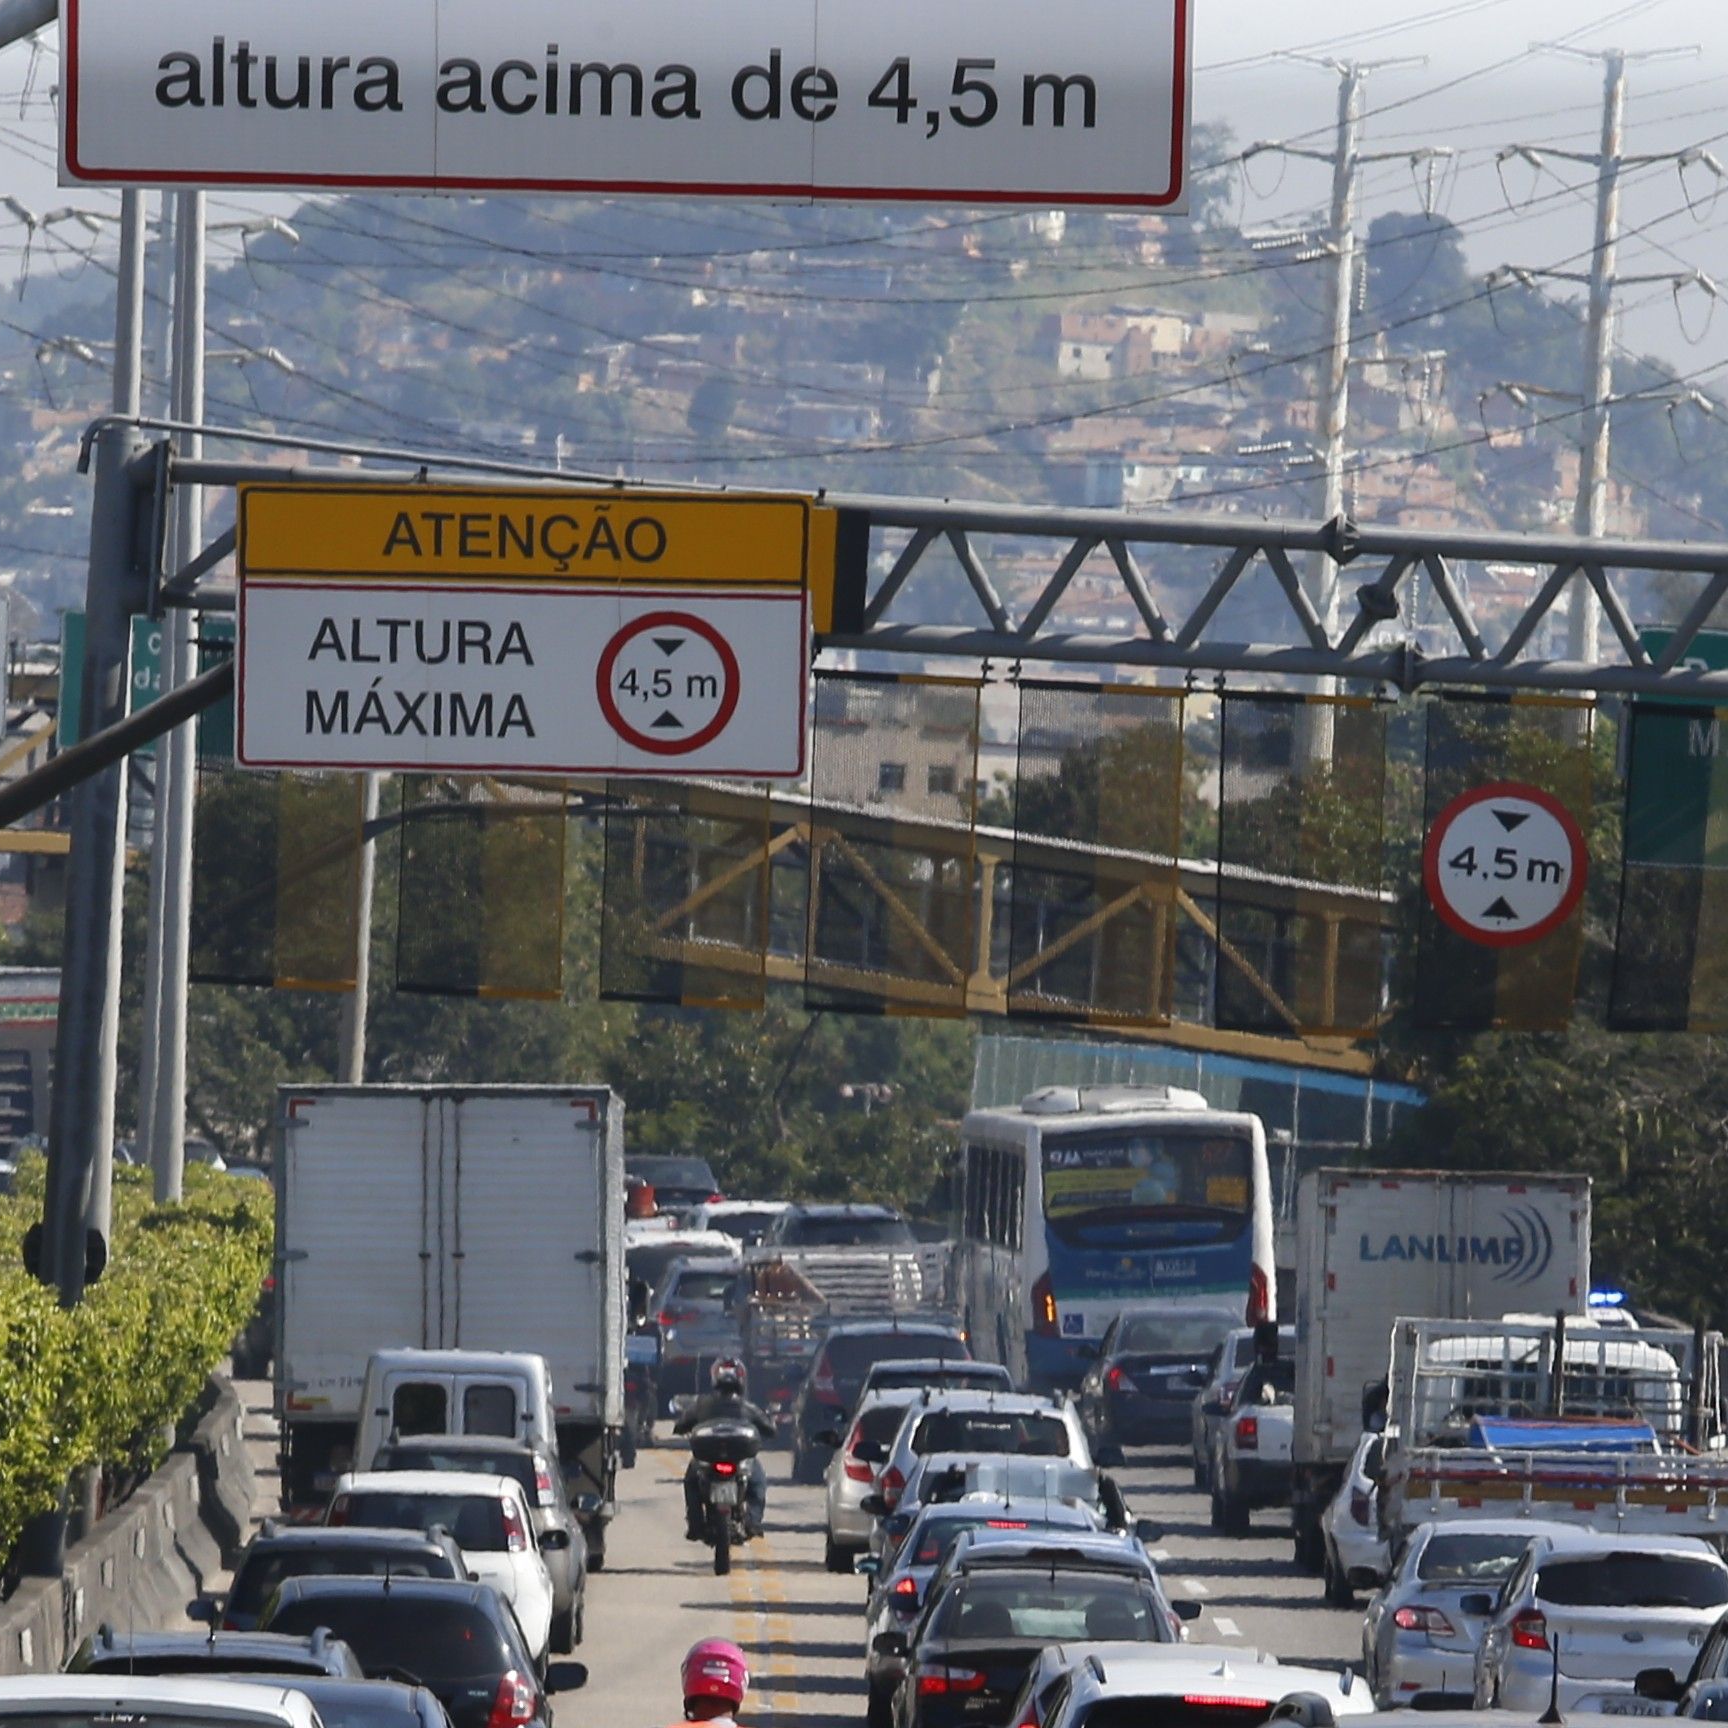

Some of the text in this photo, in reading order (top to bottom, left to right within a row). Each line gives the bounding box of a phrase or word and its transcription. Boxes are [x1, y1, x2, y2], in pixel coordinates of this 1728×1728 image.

[155, 34, 1097, 139] altura acima de 4,5 m
[382, 504, 668, 571] ATENÇÃO
[308, 618, 535, 666] ALTURA
[304, 677, 537, 738] MÁXIMA
[618, 667, 719, 703] 4,5 m
[1526, 858, 1562, 884] m
[1359, 1233, 1524, 1265] LANLIMP
